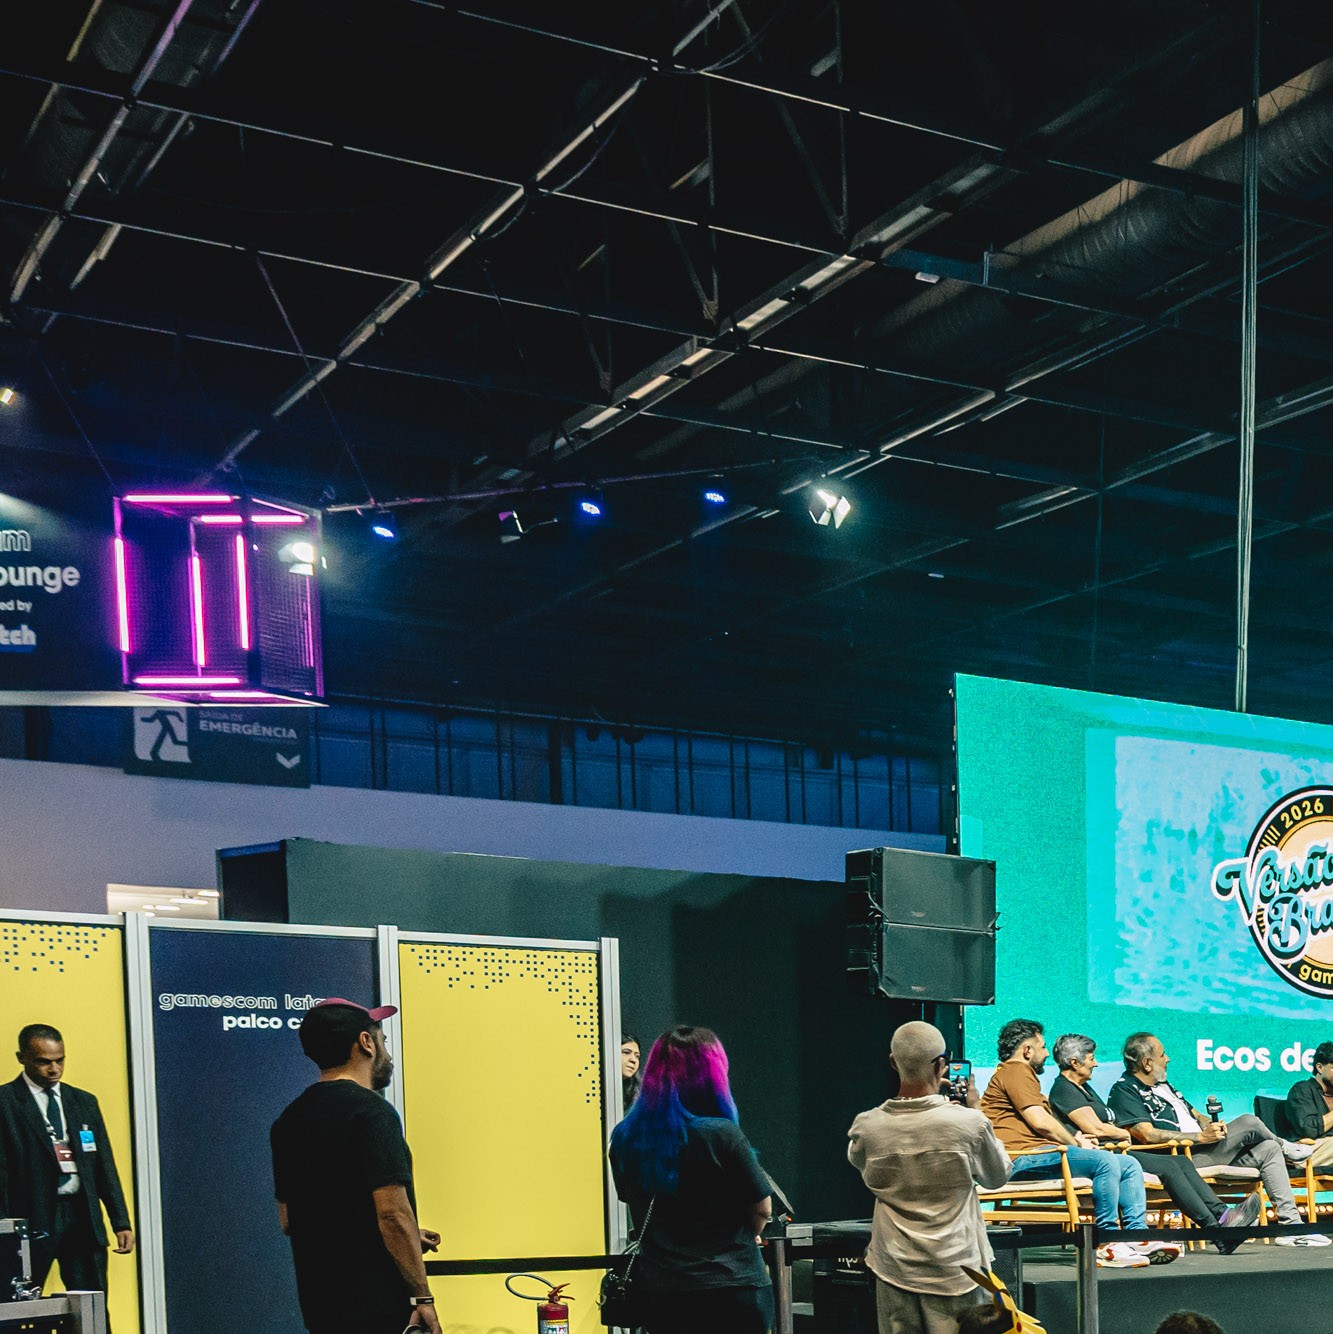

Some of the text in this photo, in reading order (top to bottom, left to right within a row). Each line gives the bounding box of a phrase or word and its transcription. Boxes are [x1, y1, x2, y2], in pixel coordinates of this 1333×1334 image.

[17, 600, 33, 613] by
[199, 720, 298, 739] EMERGÊNCIA
[1280, 799, 1325, 829] 2026
[158, 993, 278, 1011] gamescom
[223, 1013, 283, 1031] palco
[1196, 1038, 1272, 1072] Ecos
